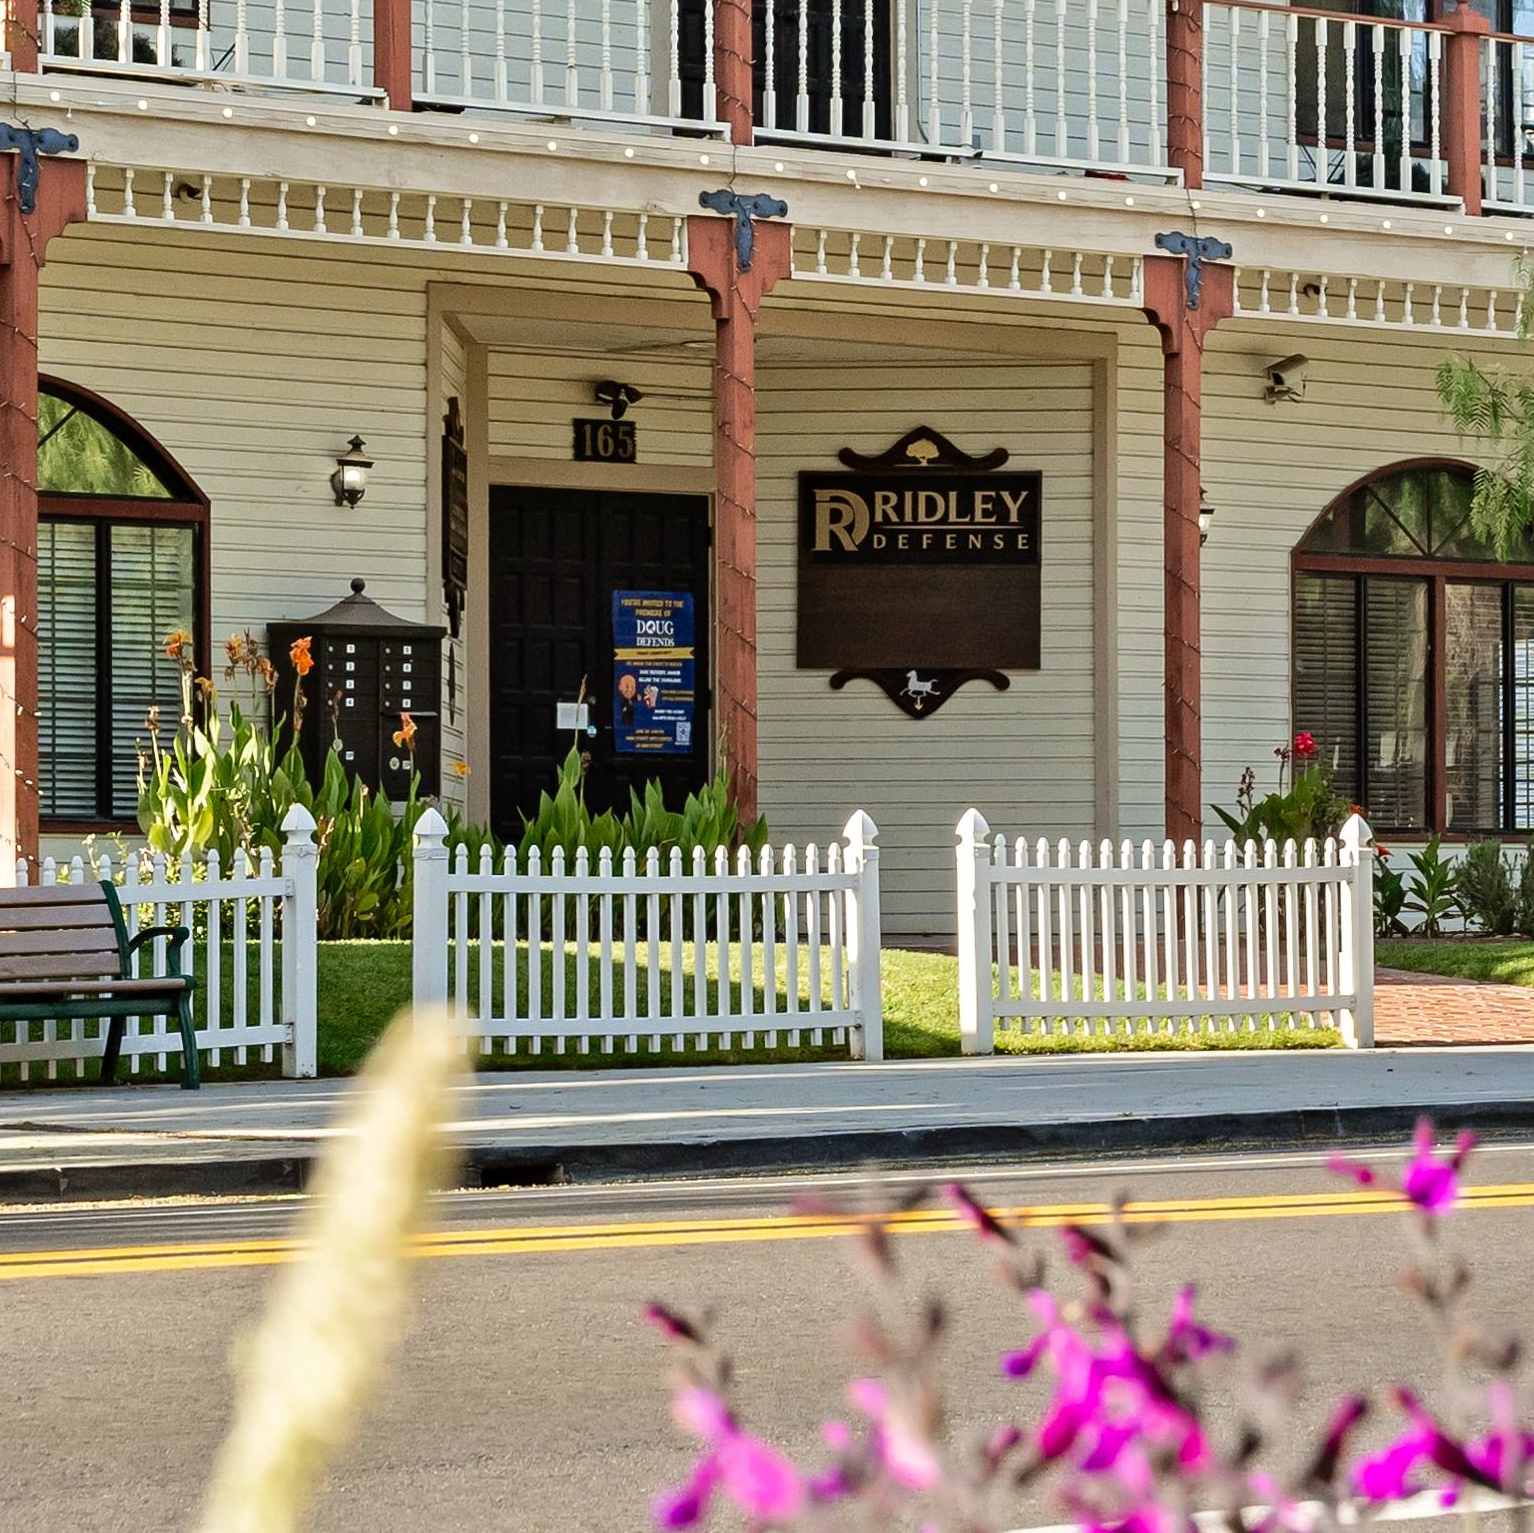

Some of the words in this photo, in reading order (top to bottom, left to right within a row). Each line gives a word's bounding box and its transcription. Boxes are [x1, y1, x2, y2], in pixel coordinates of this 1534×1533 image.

[580, 423, 634, 459] 165
[873, 490, 1029, 523] RIDLEY
[873, 533, 1029, 550] DEFENSE
[636, 619, 674, 635] DOUG
[636, 636, 675, 647] DEFENDS
